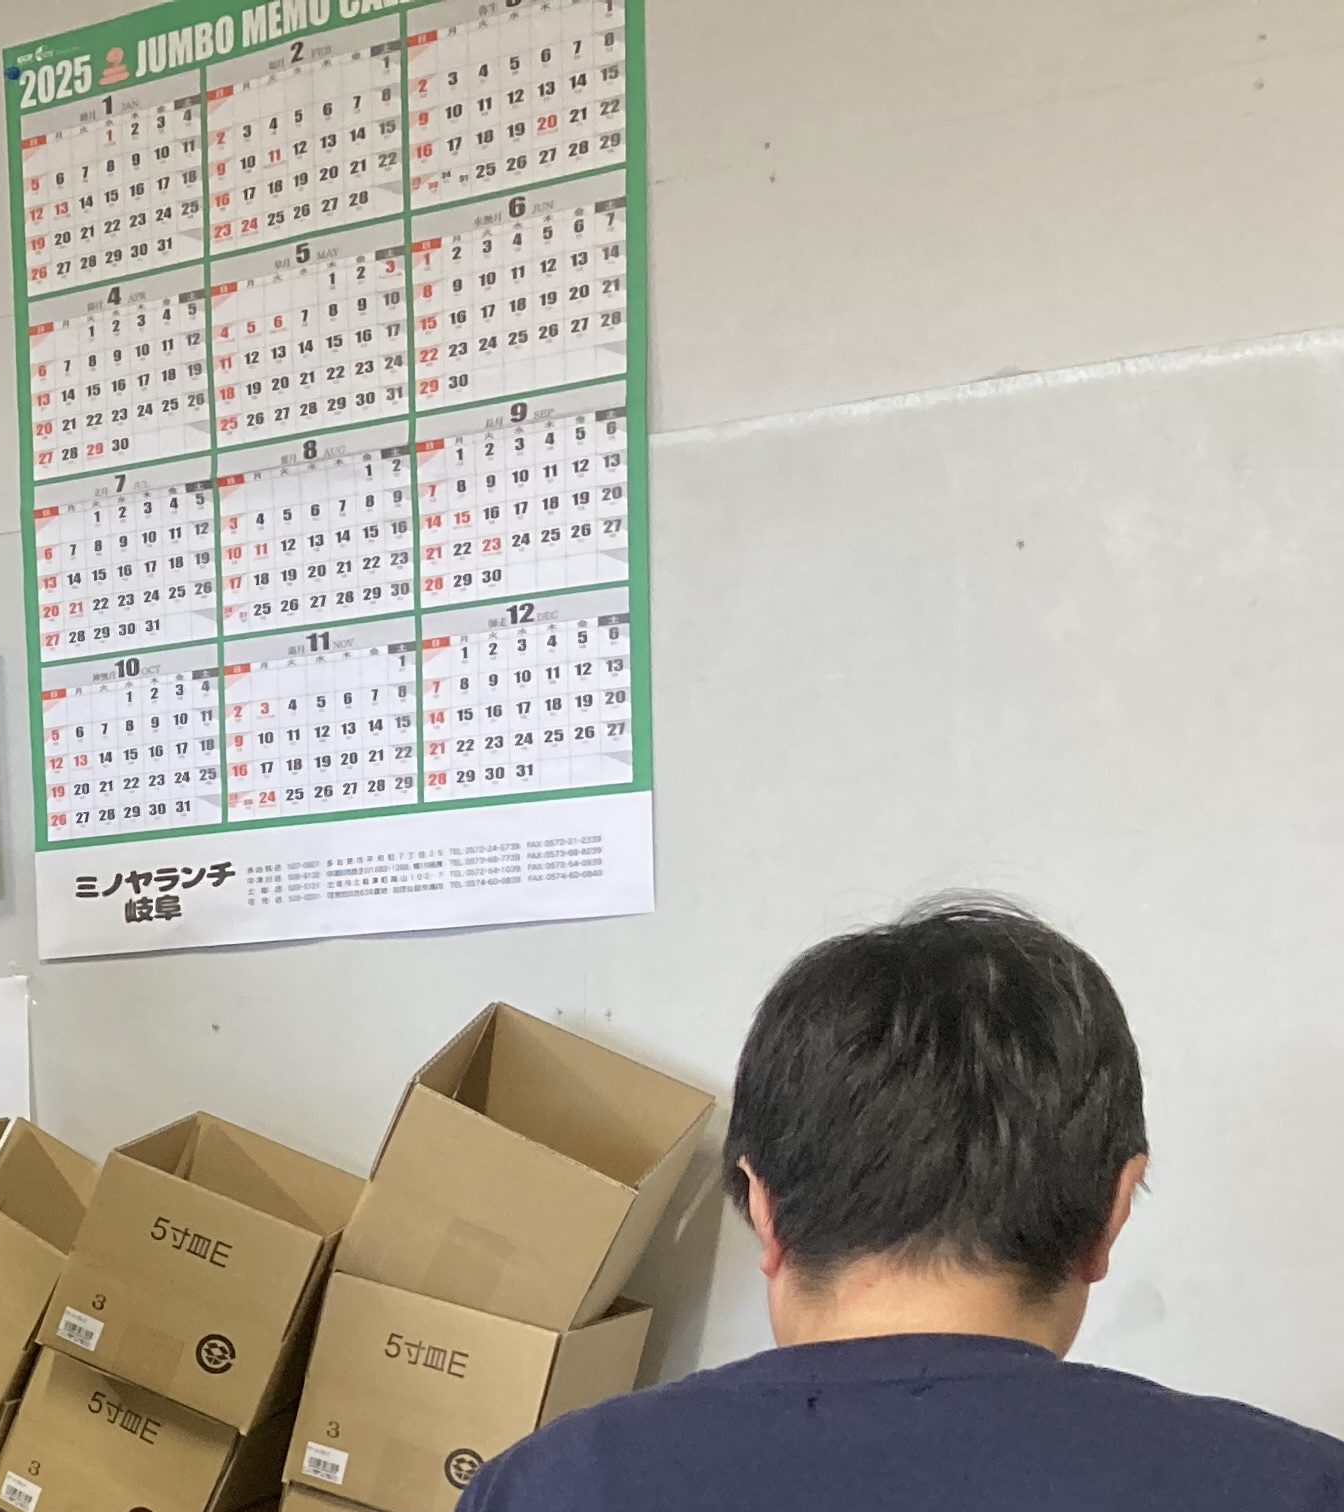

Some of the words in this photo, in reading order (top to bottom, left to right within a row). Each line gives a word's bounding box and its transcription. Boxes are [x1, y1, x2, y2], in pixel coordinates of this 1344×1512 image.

[20, 55, 91, 108] 2025
[135, 16, 234, 78] JUMBO
[242, 0, 330, 48] MEMO
[290, 41, 304, 64] 2
[102, 96, 112, 115] 1
[509, 196, 526, 218] 6
[532, 201, 554, 215] JUN
[30, 236, 45, 250] 19
[54, 231, 71, 245] 20
[80, 225, 94, 239] 21
[104, 219, 120, 234] 22
[130, 213, 146, 228] 23
[156, 206, 172, 222] 24
[181, 200, 199, 216] 25
[296, 242, 310, 264] 5
[316, 248, 339, 260] MAY
[422, 283, 432, 298] 8
[453, 279, 462, 292] 9
[479, 272, 496, 286] 10
[511, 265, 525, 280] 11
[540, 258, 556, 273] 12
[570, 252, 588, 267] 13
[602, 244, 620, 260] 14
[107, 286, 121, 305] 4
[510, 402, 528, 423] 9
[534, 409, 555, 420] SEP
[303, 440, 317, 460] 8
[115, 474, 126, 493] 7
[424, 575, 443, 591] 28
[453, 573, 472, 587] 29
[482, 569, 501, 583] 30
[506, 603, 535, 625] 12
[537, 610, 559, 621] DEC
[306, 631, 329, 652] 11
[333, 638, 356, 649] NOV
[114, 658, 140, 678] 10
[141, 666, 161, 676] OCT
[428, 710, 445, 724] 14
[457, 708, 473, 721] 15
[485, 705, 502, 718] 16
[516, 701, 531, 714] 17
[545, 698, 562, 711] 18
[575, 694, 593, 708] 19
[605, 689, 626, 705] 20
[75, 860, 236, 902] ミノヤランチ
[124, 893, 183, 924] 岐阜
[150, 1215, 234, 1268] 5寸皿E
[92, 1294, 106, 1311] 3
[383, 1333, 469, 1379] 5寸皿E
[87, 1391, 161, 1446] 5寸皿E
[327, 1420, 340, 1438] 3
[28, 1460, 41, 1476] 3
